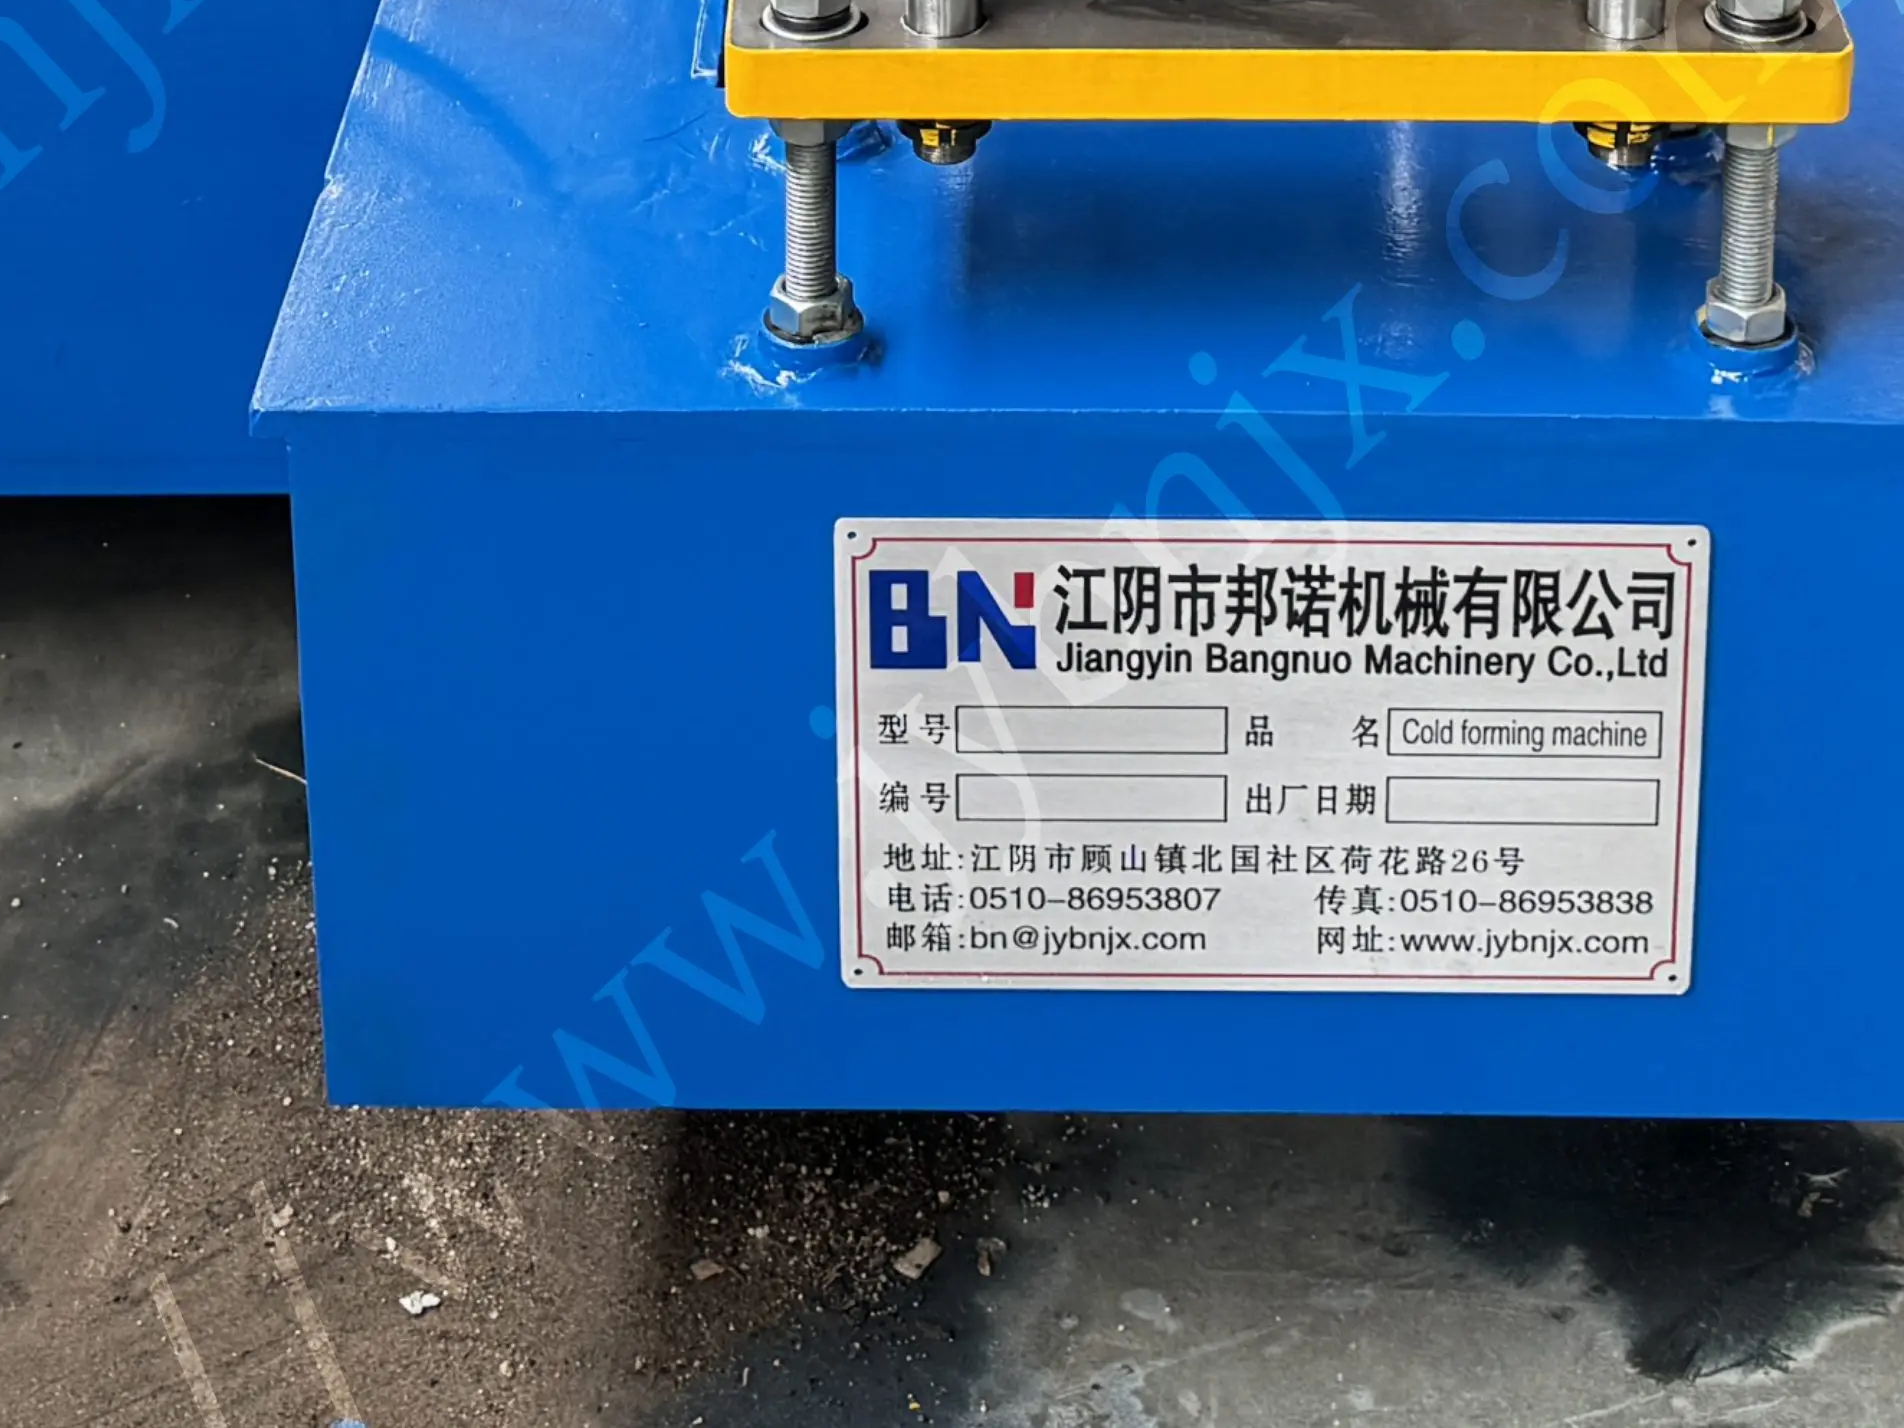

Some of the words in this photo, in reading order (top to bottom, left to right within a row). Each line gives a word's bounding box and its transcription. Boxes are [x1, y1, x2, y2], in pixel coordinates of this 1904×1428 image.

[868, 569, 1037, 670] BN
[1053, 564, 1677, 640] 江阴市邦诺机械有限公司
[1056, 641, 1193, 681] Jiangyin
[1205, 642, 1352, 682] Bangnuo
[1364, 643, 1536, 684] Machinery
[1547, 645, 1669, 683] Co.,Ltd
[878, 713, 951, 745] 型号
[1402, 718, 1453, 745] Cold
[1461, 719, 1544, 753] forming
[1552, 720, 1647, 747] machine
[879, 780, 951, 814] 编号
[1246, 783, 1376, 815] 出厂日期
